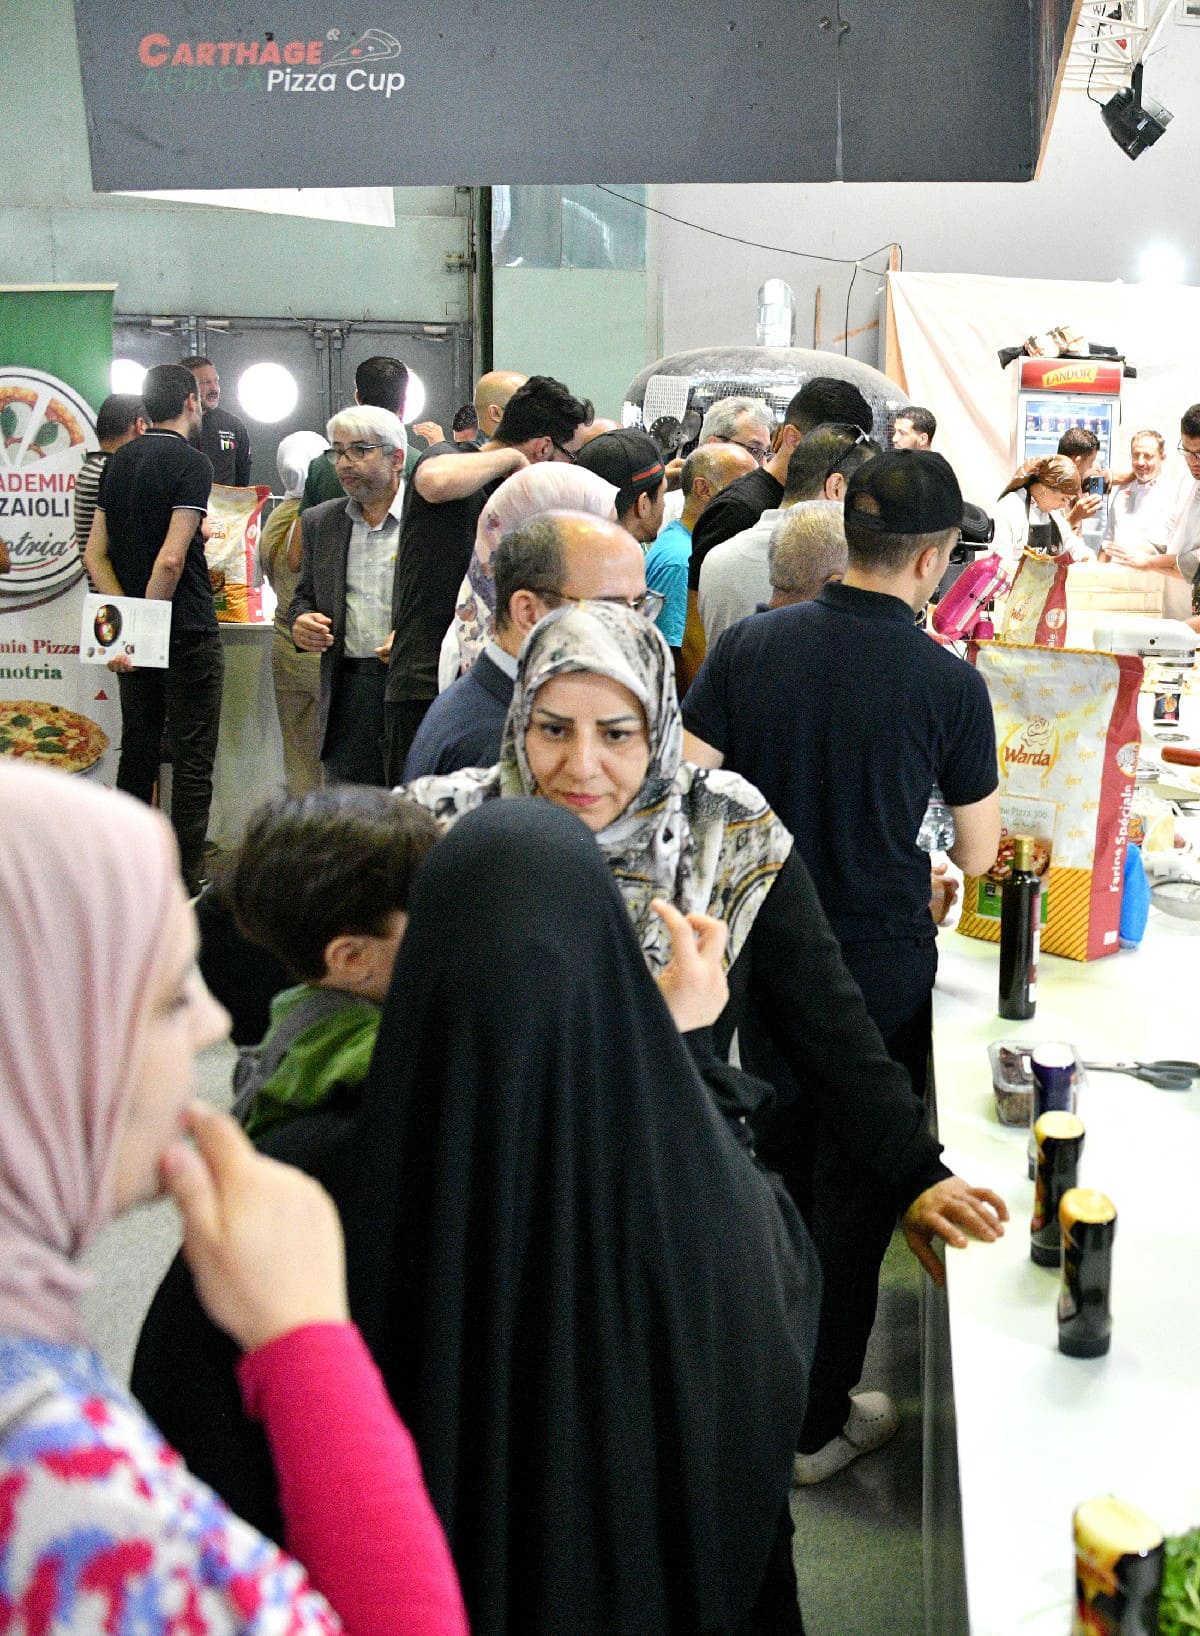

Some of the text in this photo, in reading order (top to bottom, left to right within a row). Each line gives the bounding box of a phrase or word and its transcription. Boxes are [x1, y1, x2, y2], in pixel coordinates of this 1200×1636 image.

[139, 33, 324, 67] CARTHAGE
[267, 69, 336, 91] Pizza
[346, 69, 405, 98] Cup
[1046, 367, 1092, 385] LANDOR
[33, 639, 80, 654] Pizza
[1004, 744, 1050, 767] Warda
[1110, 848, 1124, 892] Farine
